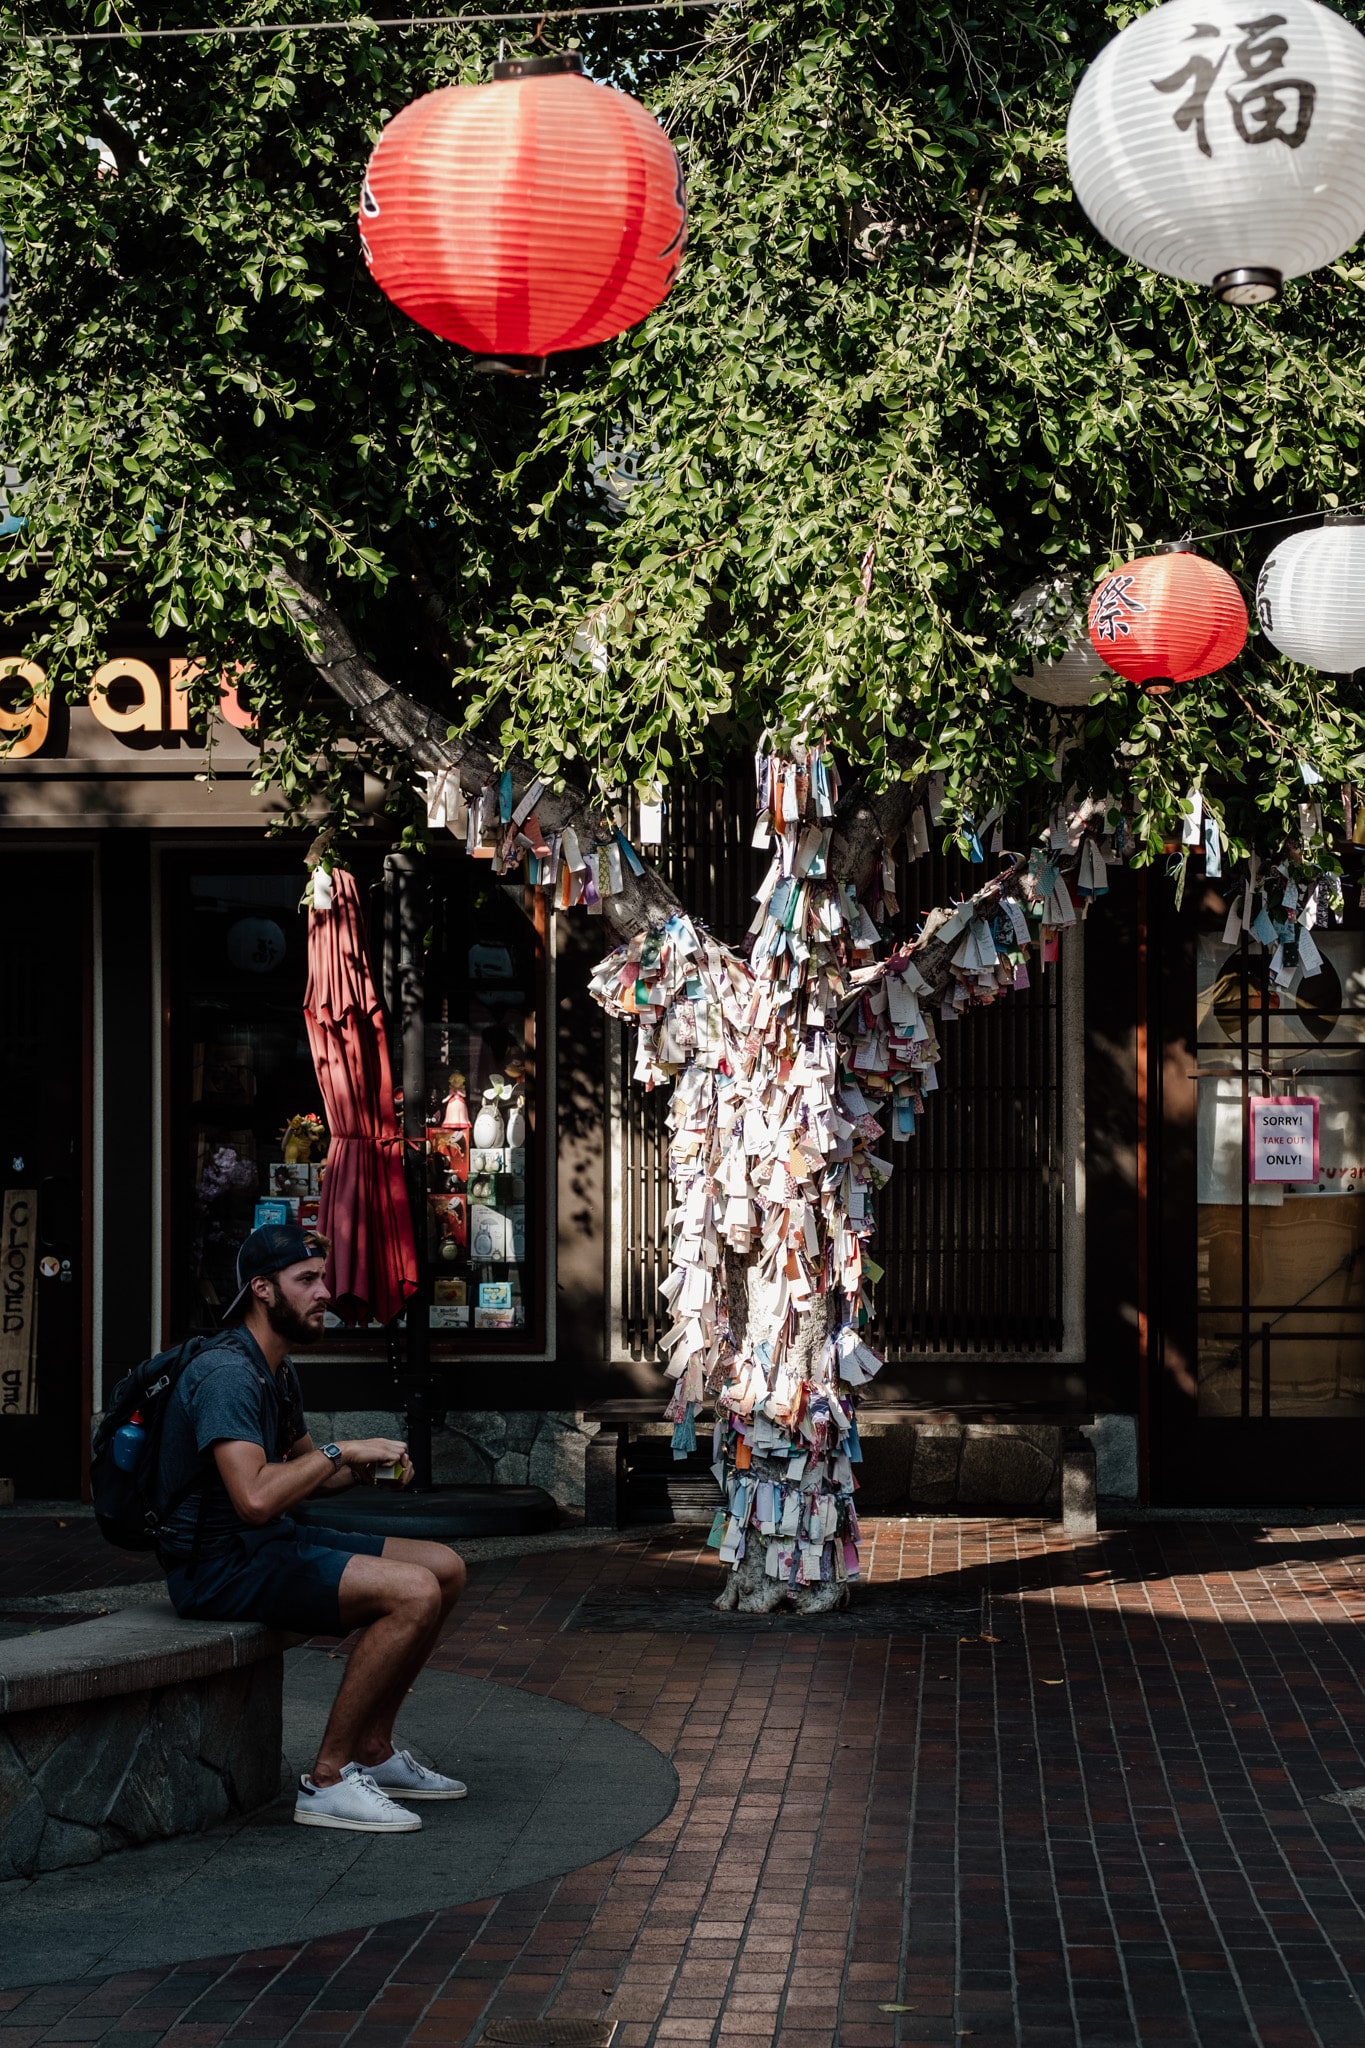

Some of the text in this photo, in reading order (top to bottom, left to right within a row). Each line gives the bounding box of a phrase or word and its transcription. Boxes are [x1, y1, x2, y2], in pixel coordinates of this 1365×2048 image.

[1150, 14, 1317, 158] 福
[1090, 575, 1146, 642] 祭
[1263, 1116, 1303, 1126] SORRY!
[1263, 1136, 1306, 1145] TAKE OUT
[1266, 1155, 1302, 1165] ONLY!
[3, 1202, 28, 1333] CLOSED
